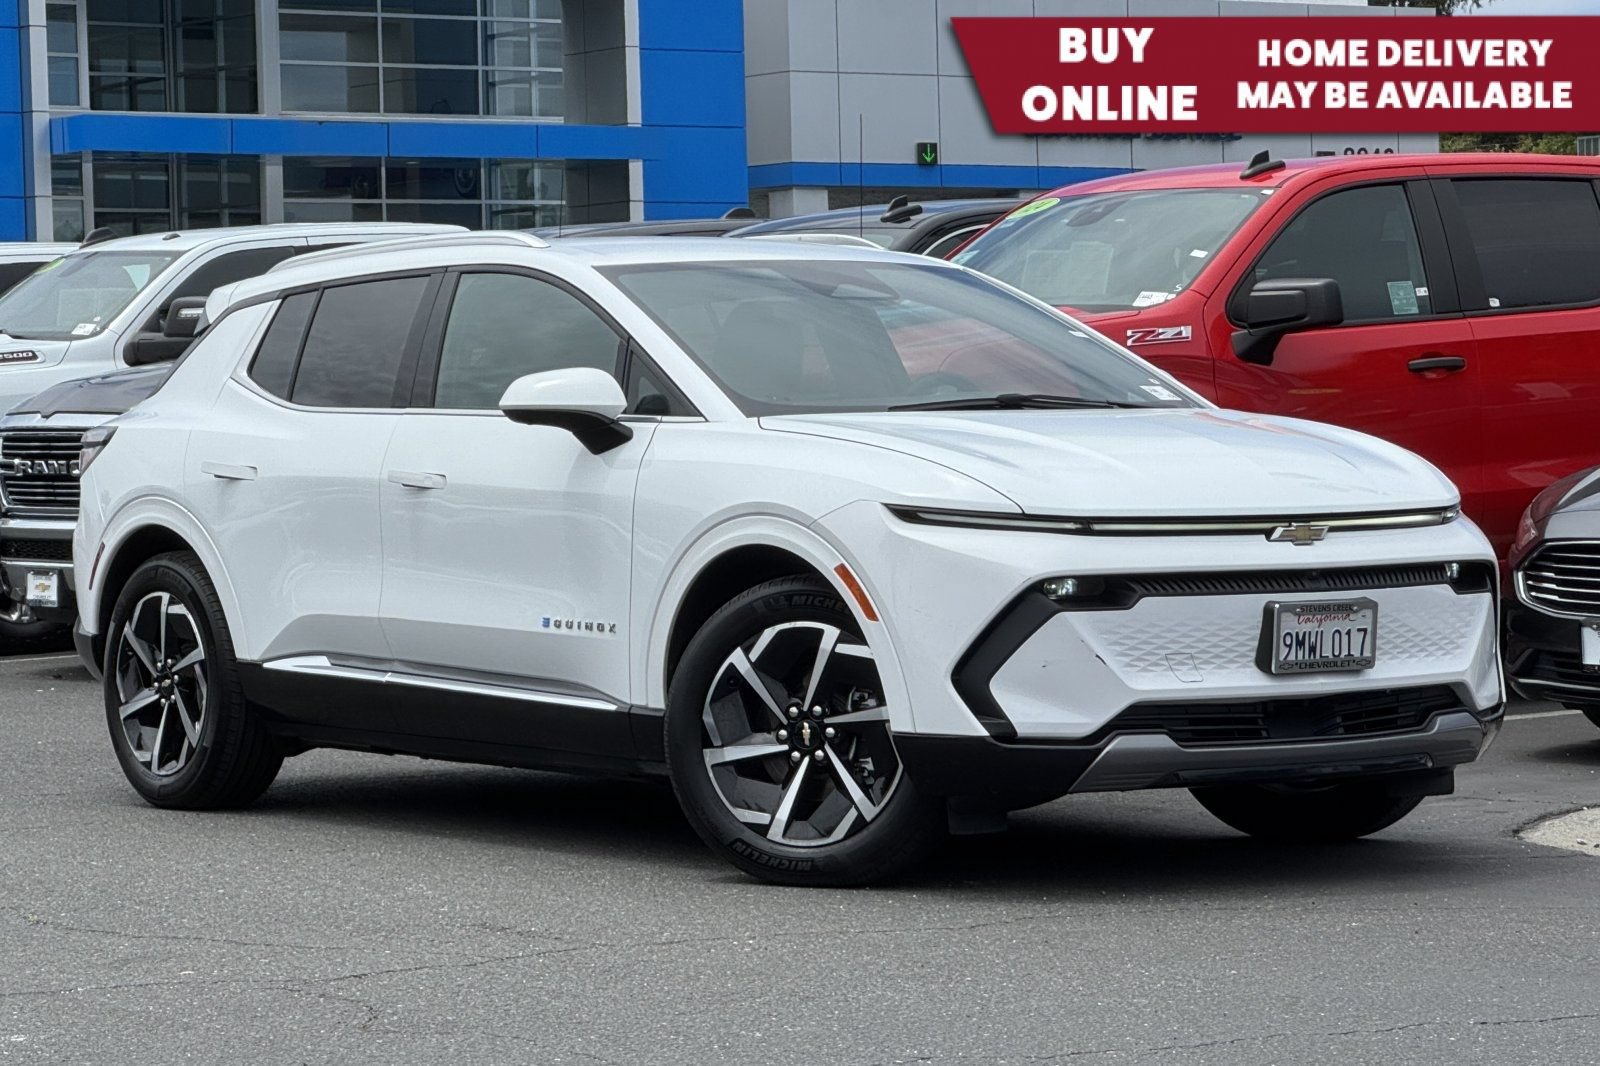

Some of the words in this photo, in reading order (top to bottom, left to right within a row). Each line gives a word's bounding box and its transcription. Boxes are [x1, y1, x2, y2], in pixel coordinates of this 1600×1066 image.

[1126, 325, 1193, 347] Z71
[14, 459, 68, 476] RAM
[1300, 604, 1331, 613] STEVENS
[1332, 603, 1354, 612] CREEK
[541, 616, 617, 634] EQUINOX
[1297, 612, 1357, 628] California
[1282, 627, 1369, 661] 9MWL017
[1298, 660, 1351, 670] CHEVROLET
[731, 841, 814, 871] MICHELIN
